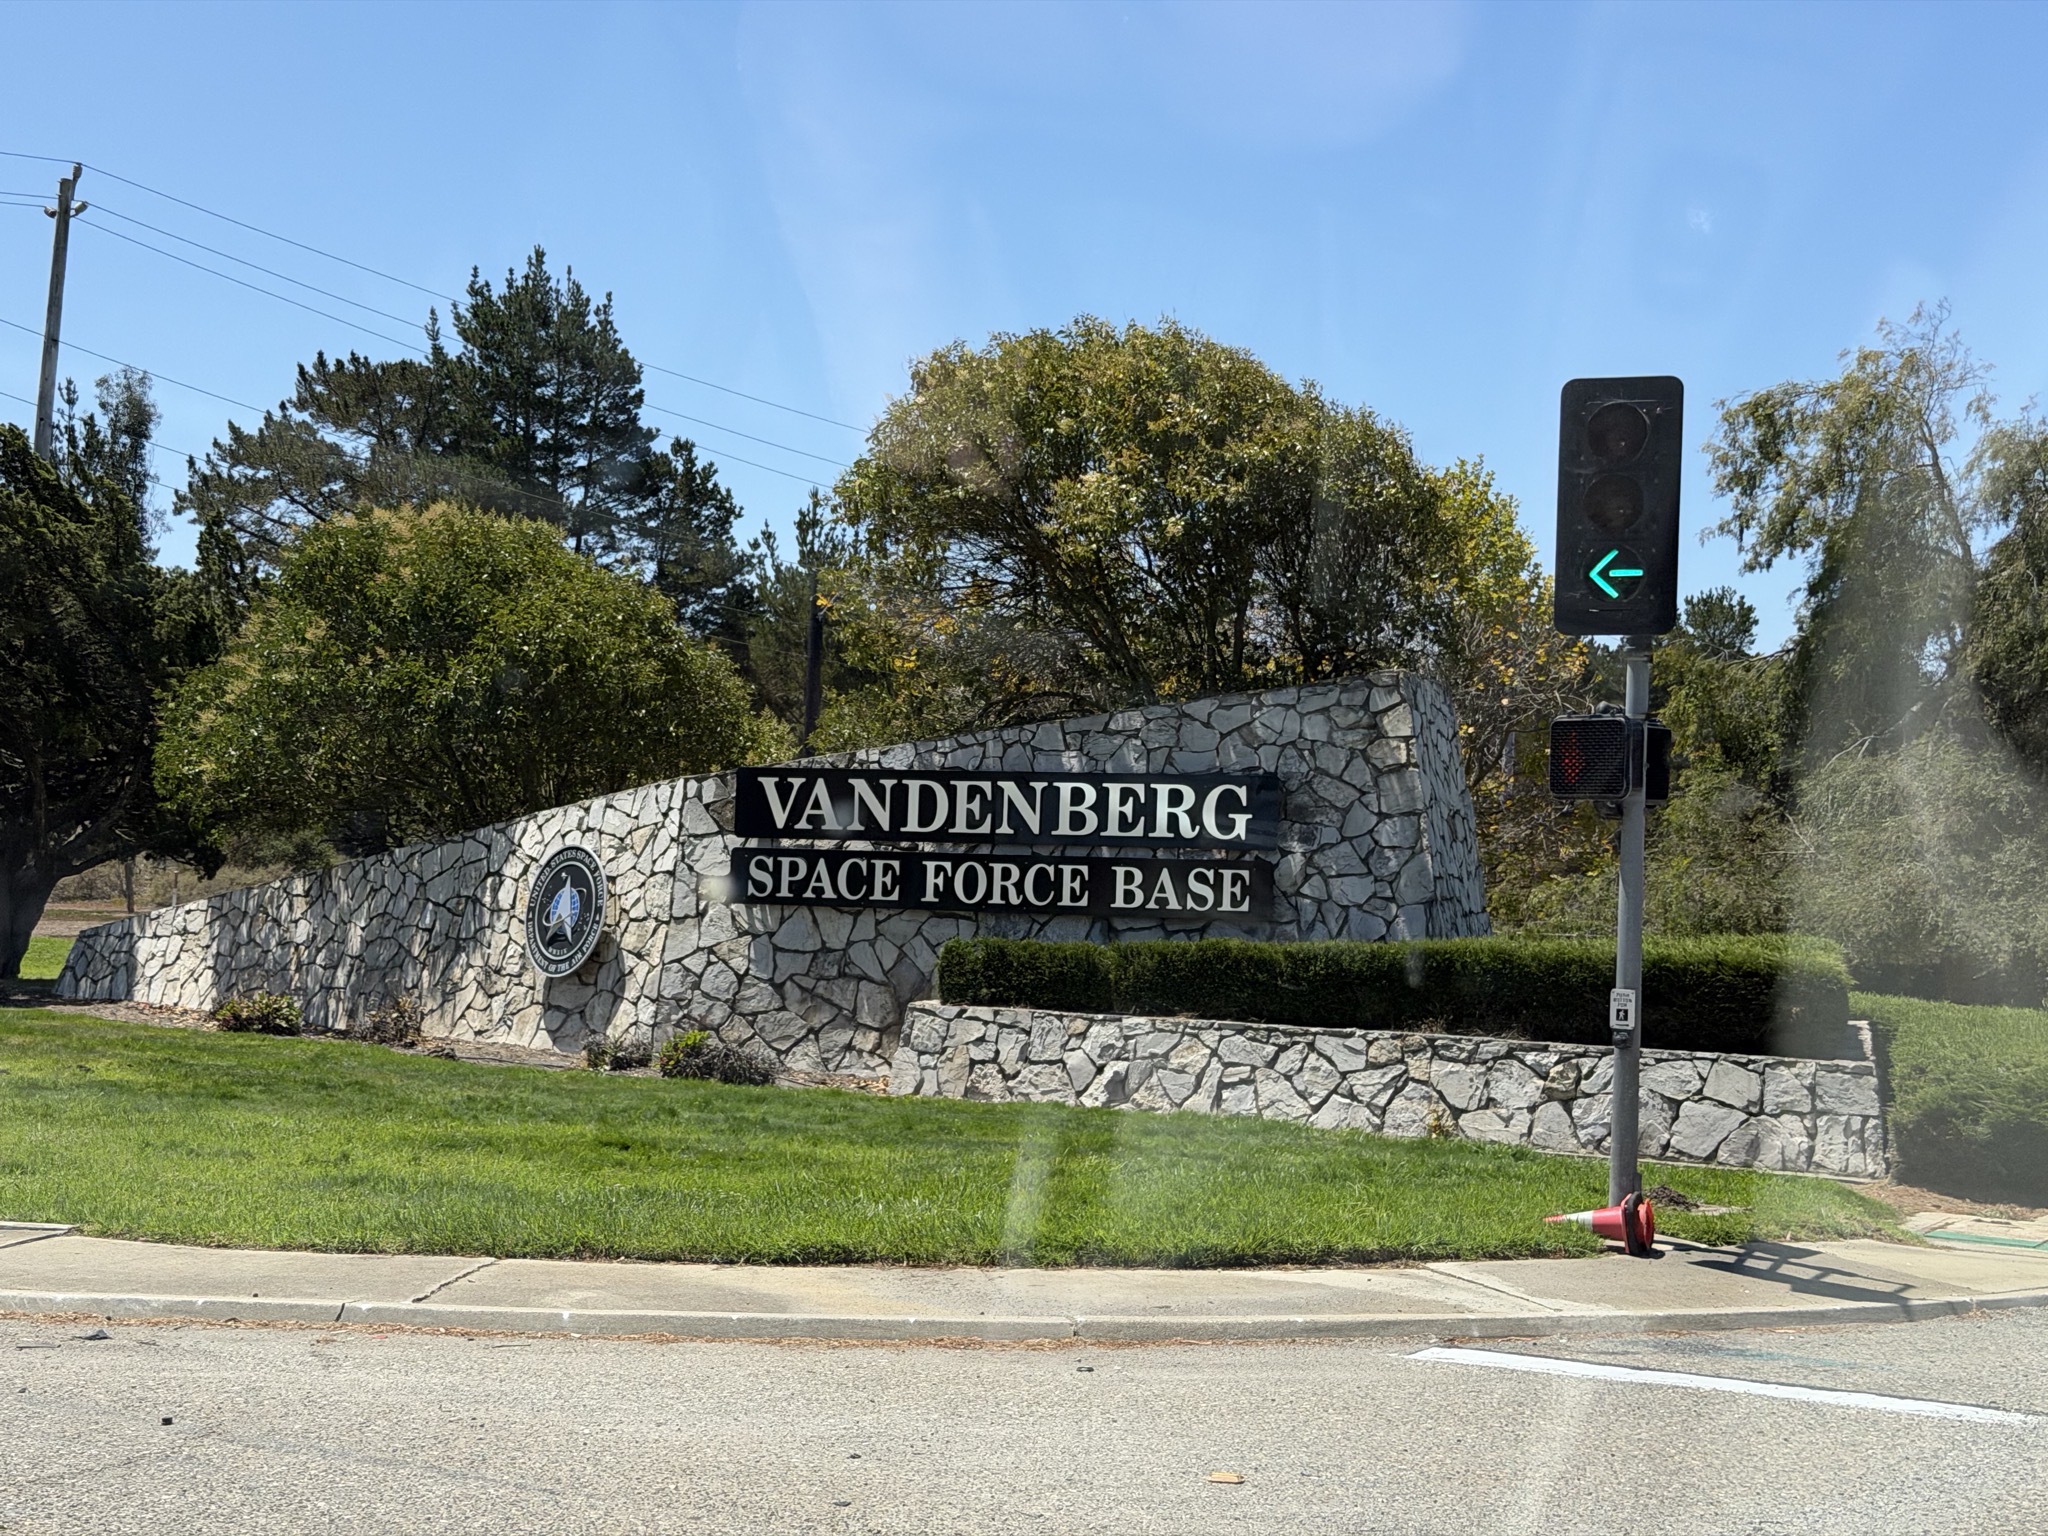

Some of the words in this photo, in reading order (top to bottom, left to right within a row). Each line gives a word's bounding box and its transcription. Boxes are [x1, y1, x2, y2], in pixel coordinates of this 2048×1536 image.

[757, 776, 1253, 841] VANDENBERG
[530, 867, 550, 907] UNITED
[550, 849, 577, 868] STATES
[576, 850, 597, 870] SPACE
[593, 870, 603, 907] FORCE
[746, 855, 901, 902] SPACE
[921, 860, 1089, 907] FORCE
[1109, 865, 1253, 912] BASE
[528, 921, 548, 969] DEPARTMENT
[557, 961, 570, 972] THE
[571, 950, 582, 966] AIR
[582, 923, 598, 953] FORCE
